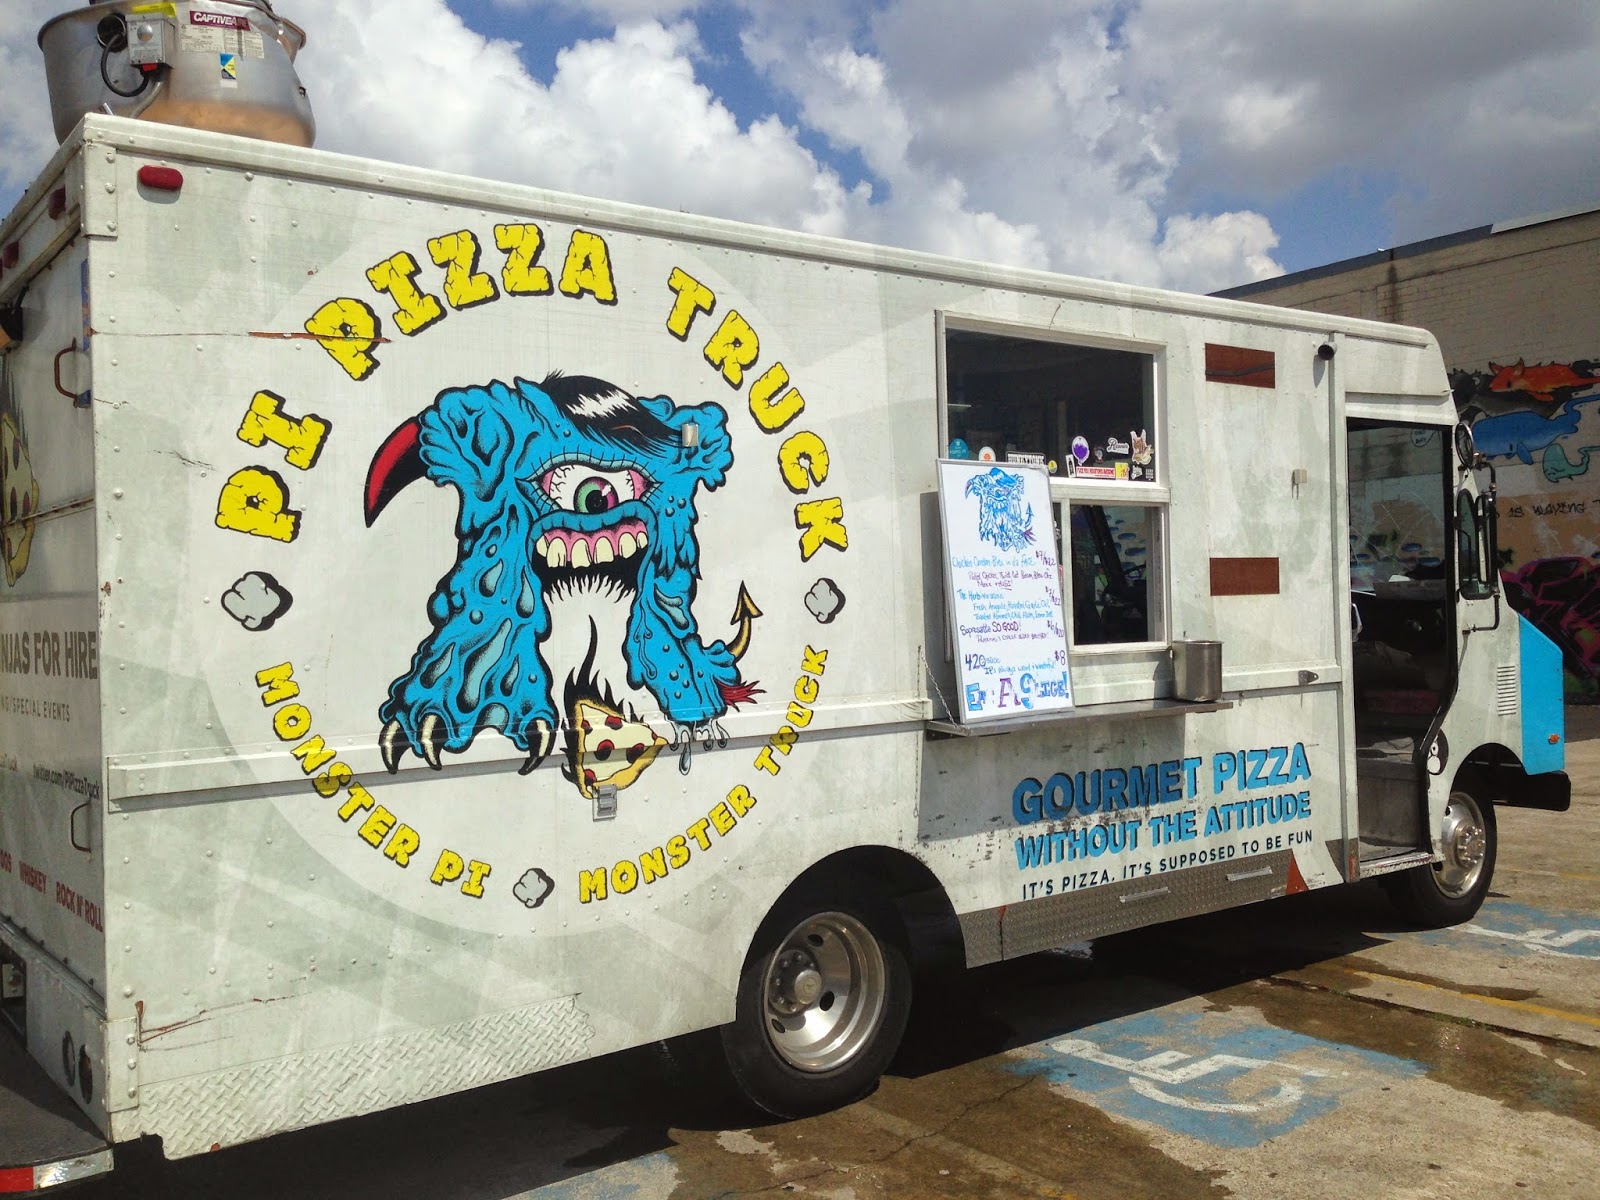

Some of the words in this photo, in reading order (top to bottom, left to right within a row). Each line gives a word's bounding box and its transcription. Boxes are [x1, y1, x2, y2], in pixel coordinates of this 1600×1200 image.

[215, 390, 332, 543] PI
[304, 223, 618, 381] PIZZA
[667, 266, 849, 561] TRUCK
[33, 630, 62, 677] FOR
[64, 631, 98, 680] HIRE
[43, 700, 71, 723] EVENTS
[255, 662, 420, 868] MONSTER
[431, 849, 492, 898] PI
[578, 784, 756, 903] MONSTER
[754, 643, 828, 776] TRUCK
[1012, 756, 1203, 825] GOURMET
[1213, 742, 1311, 795] PIZZA
[1015, 820, 1141, 870] WITHOUT
[1149, 810, 1197, 847] THE
[1204, 791, 1311, 836] ATTITUDE
[1022, 879, 1054, 900] IT'S
[1123, 857, 1152, 879] IT'S
[1160, 846, 1235, 872] SUPPOSED
[1242, 840, 1259, 855] TO
[1266, 834, 1283, 850] BE
[1288, 829, 1313, 845] FUN
[18, 860, 47, 895] WHISKEY
[56, 880, 76, 914] ROCK
[85, 898, 103, 933] ROLL
